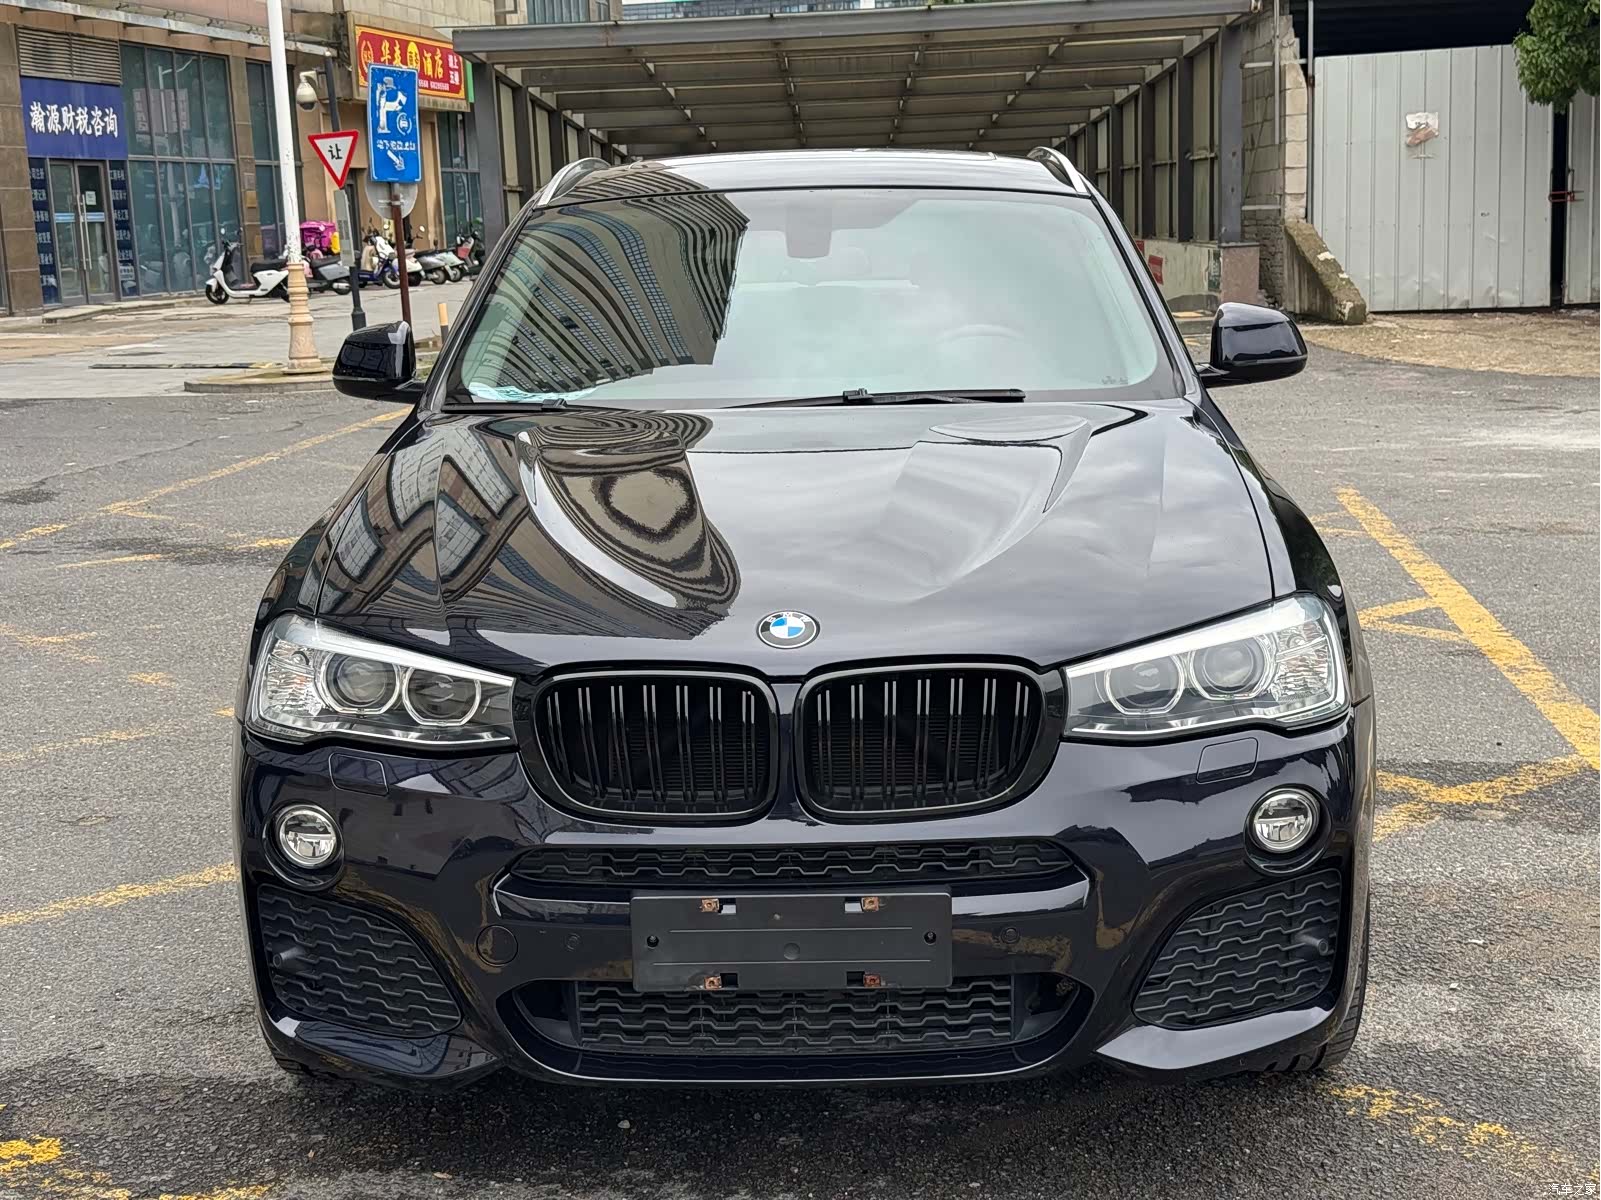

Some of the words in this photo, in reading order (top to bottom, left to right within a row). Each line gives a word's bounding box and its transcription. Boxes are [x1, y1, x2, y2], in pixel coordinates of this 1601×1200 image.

[29, 101, 118, 138] 瀚源财税咨询
[327, 143, 343, 160] 让
